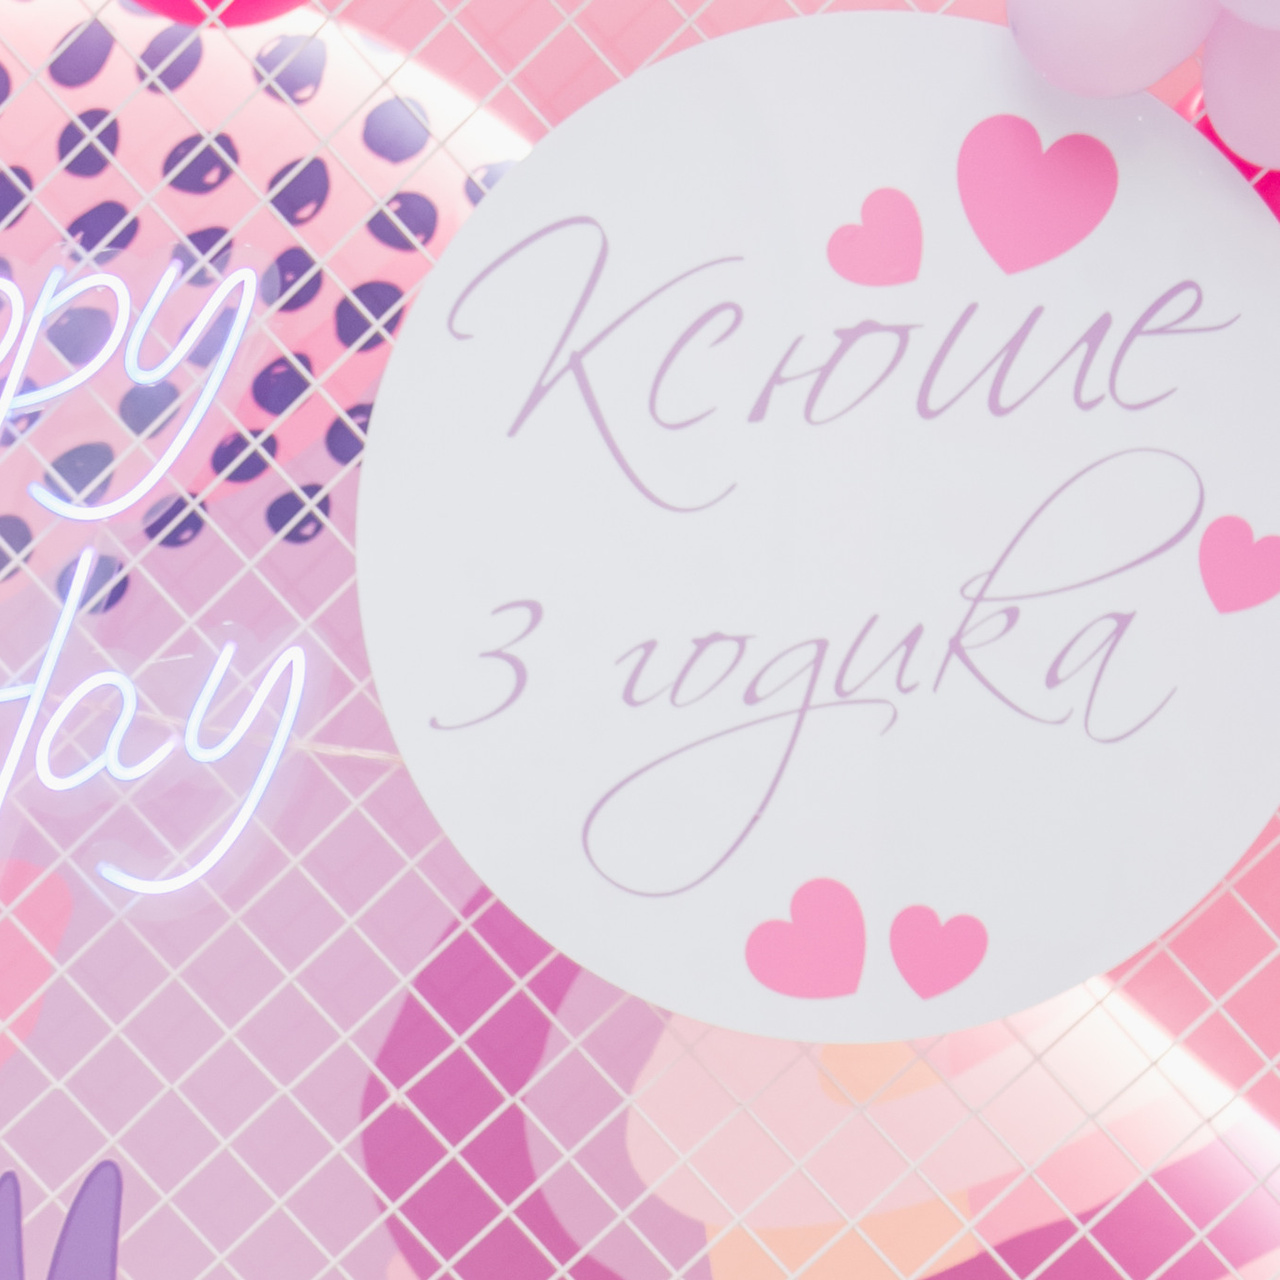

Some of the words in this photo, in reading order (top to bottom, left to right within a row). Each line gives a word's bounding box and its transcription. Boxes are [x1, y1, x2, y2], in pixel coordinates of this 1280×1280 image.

[446, 214, 1242, 513] Ксюше
[428, 598, 545, 731] 3
[582, 447, 1205, 898] годика
